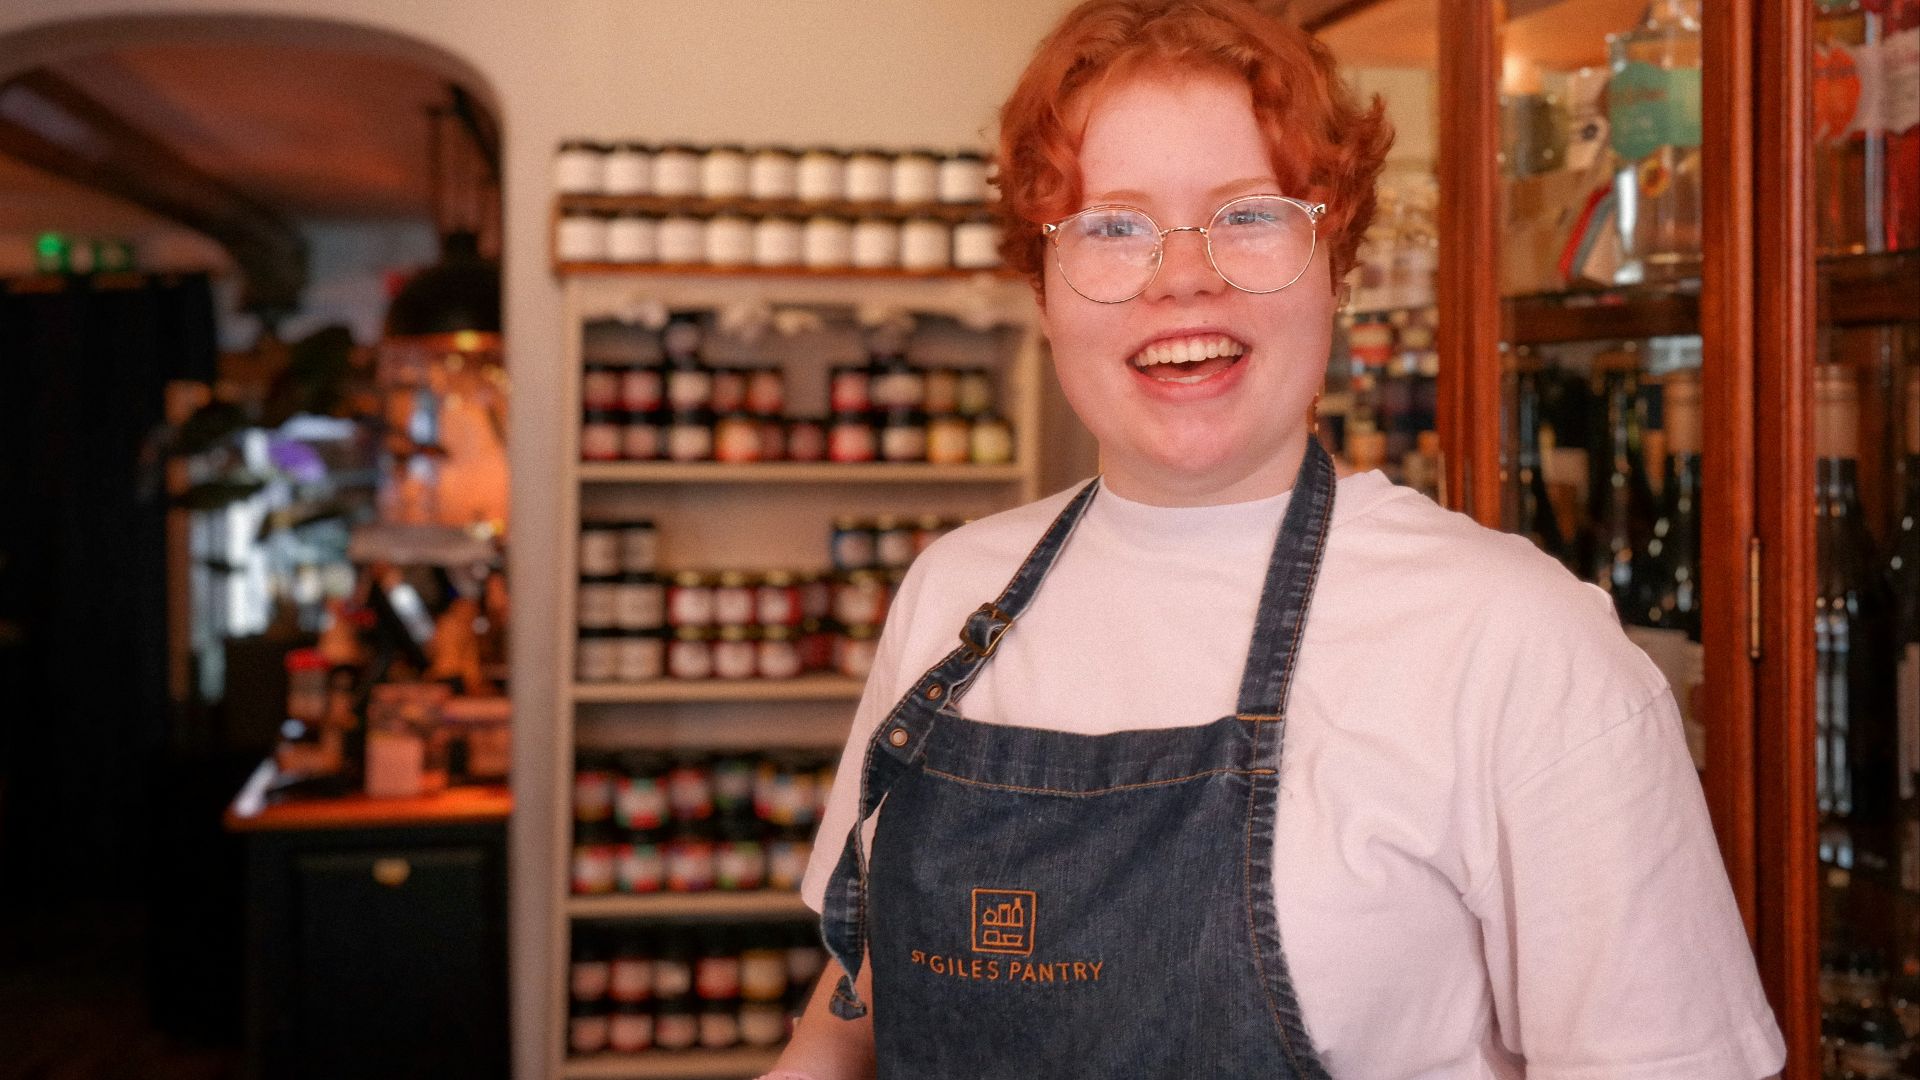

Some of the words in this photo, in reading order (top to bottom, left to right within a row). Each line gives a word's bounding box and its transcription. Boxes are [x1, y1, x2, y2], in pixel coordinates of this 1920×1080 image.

[911, 949, 926, 965] ST
[930, 955, 1000, 980] GILES
[1009, 961, 1104, 982] PANTRY
